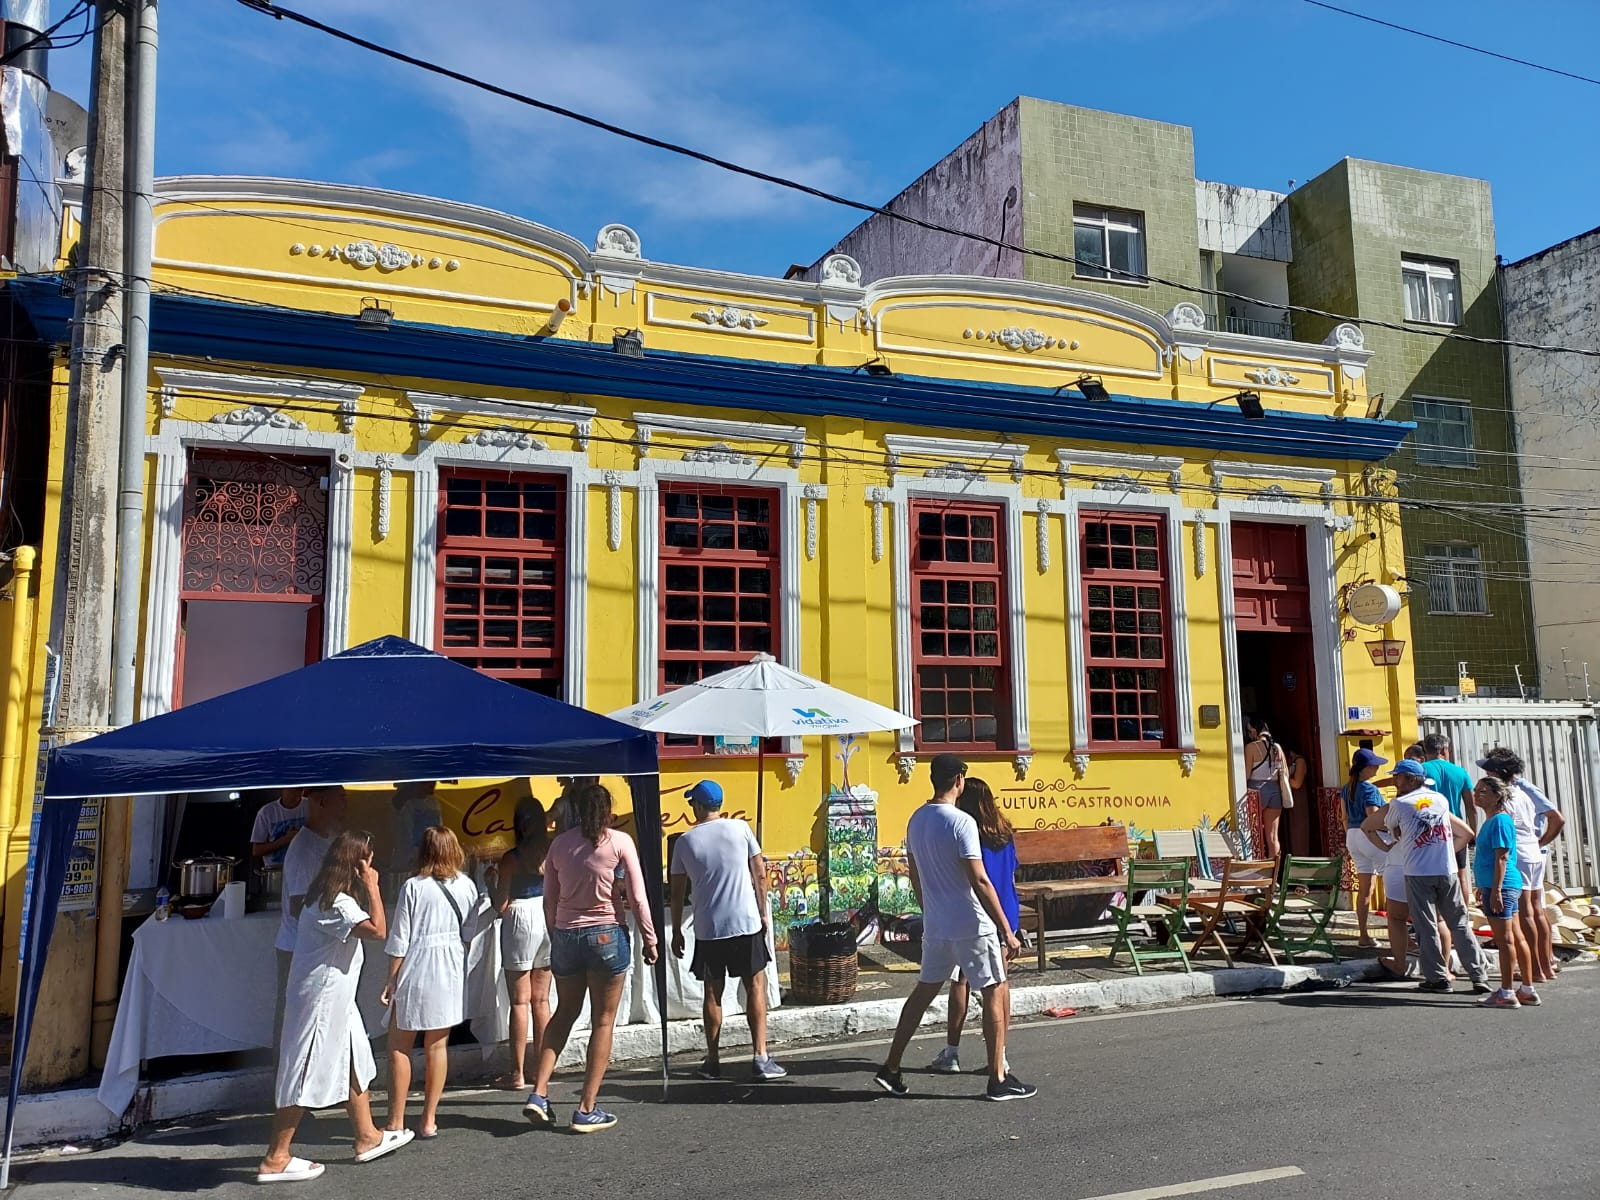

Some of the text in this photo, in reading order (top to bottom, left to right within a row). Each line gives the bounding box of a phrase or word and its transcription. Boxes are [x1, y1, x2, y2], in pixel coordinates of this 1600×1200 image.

[1359, 707, 1372, 718] 45
[791, 717, 849, 726] vidativa
[1066, 795, 1172, 809] GASTRONOMIA
